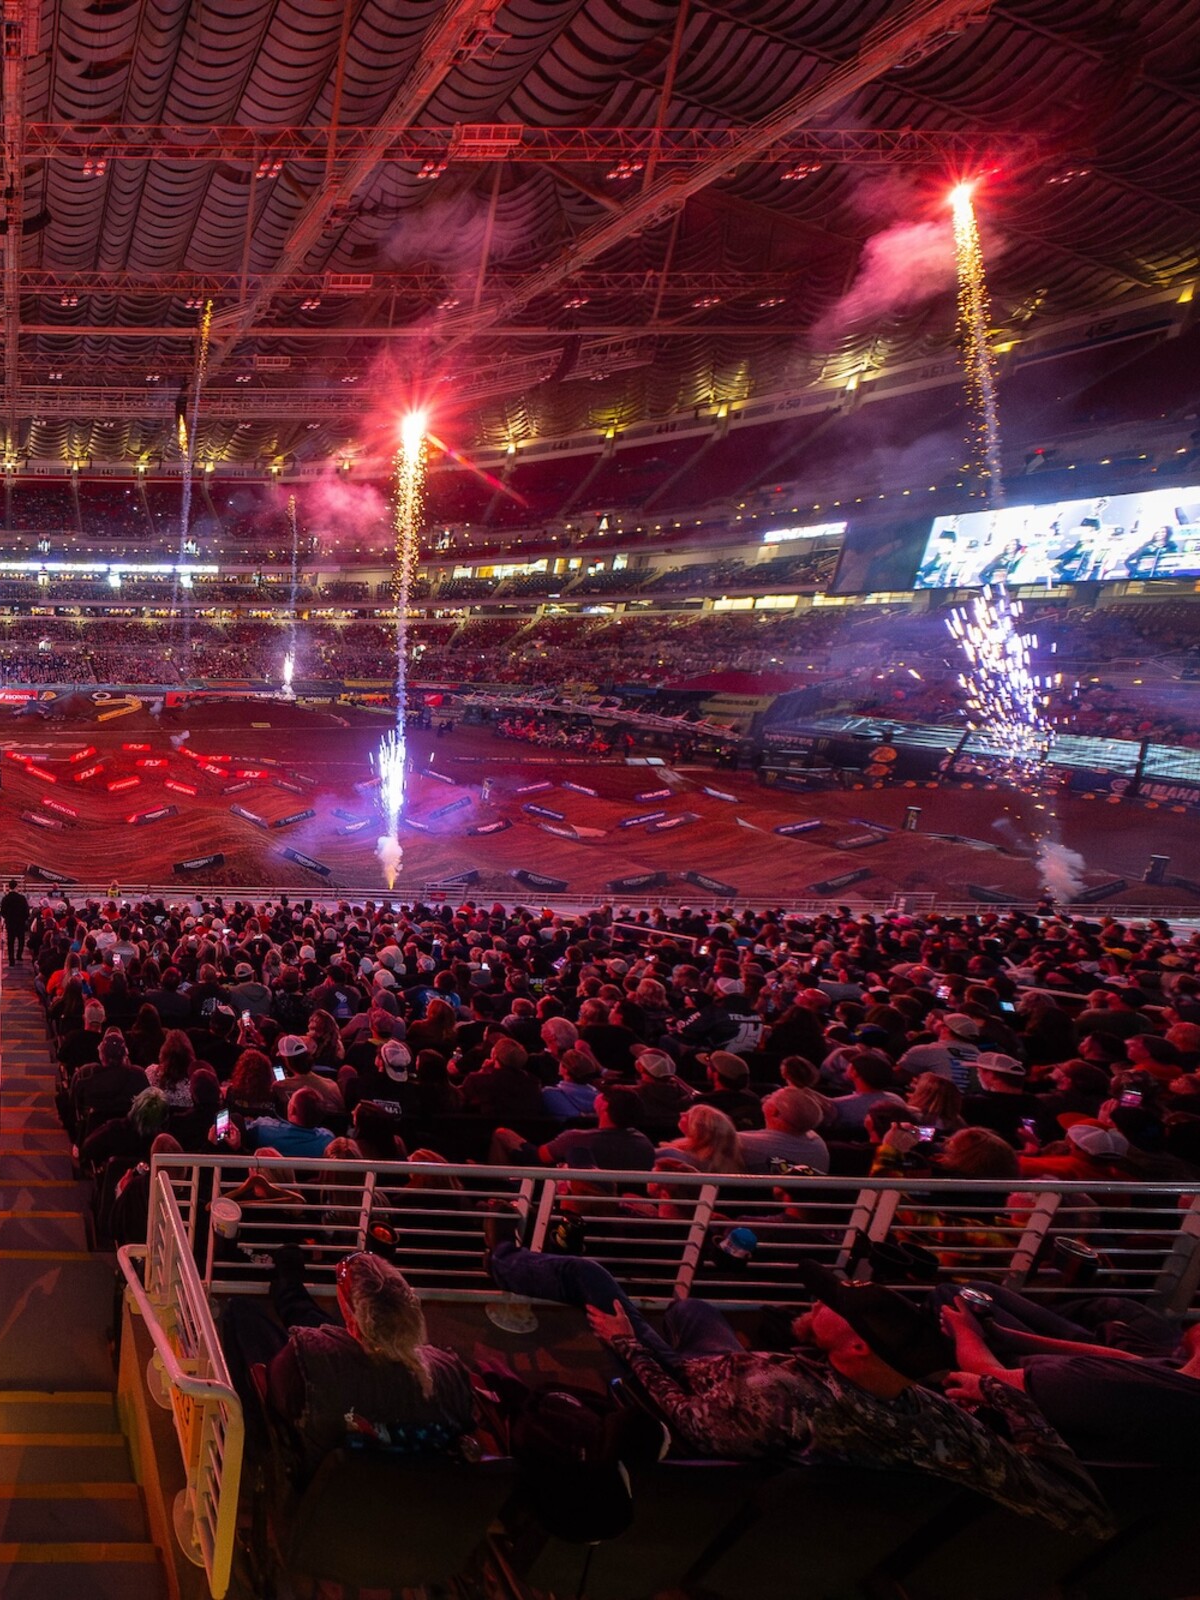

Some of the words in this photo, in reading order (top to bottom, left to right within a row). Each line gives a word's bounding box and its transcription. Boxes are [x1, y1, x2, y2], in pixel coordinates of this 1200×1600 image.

[75, 749, 89, 759] FLY
[143, 759, 161, 767] FLY
[80, 767, 96, 778] FLY
[204, 764, 221, 775] FLY
[1138, 783, 1200, 802] AMAHA
[50, 803, 77, 817] HONDA
